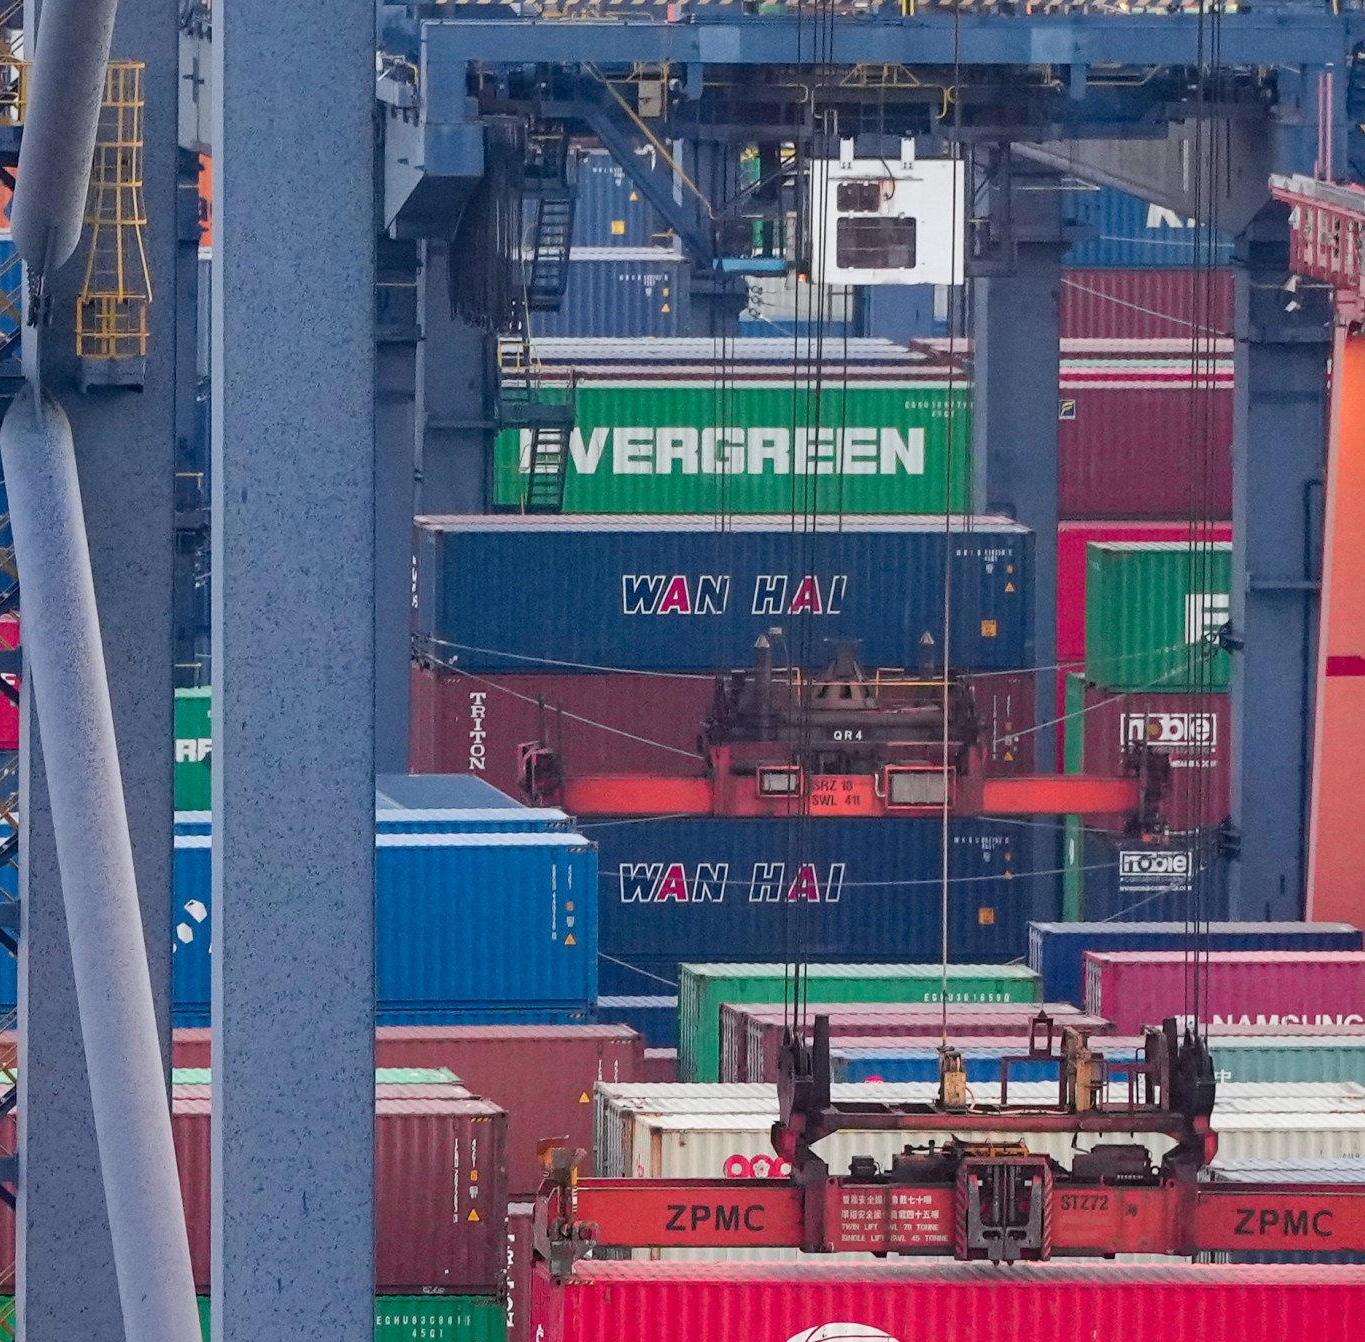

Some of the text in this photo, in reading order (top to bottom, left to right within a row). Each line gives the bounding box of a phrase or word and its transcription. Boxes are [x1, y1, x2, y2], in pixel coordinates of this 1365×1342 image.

[622, 575, 848, 615] WAN HAI
[469, 691, 487, 770] TRITON
[619, 863, 846, 903] WAN HAI
[665, 1204, 765, 1232] ZPMC
[1234, 1207, 1334, 1238] ZPMC
